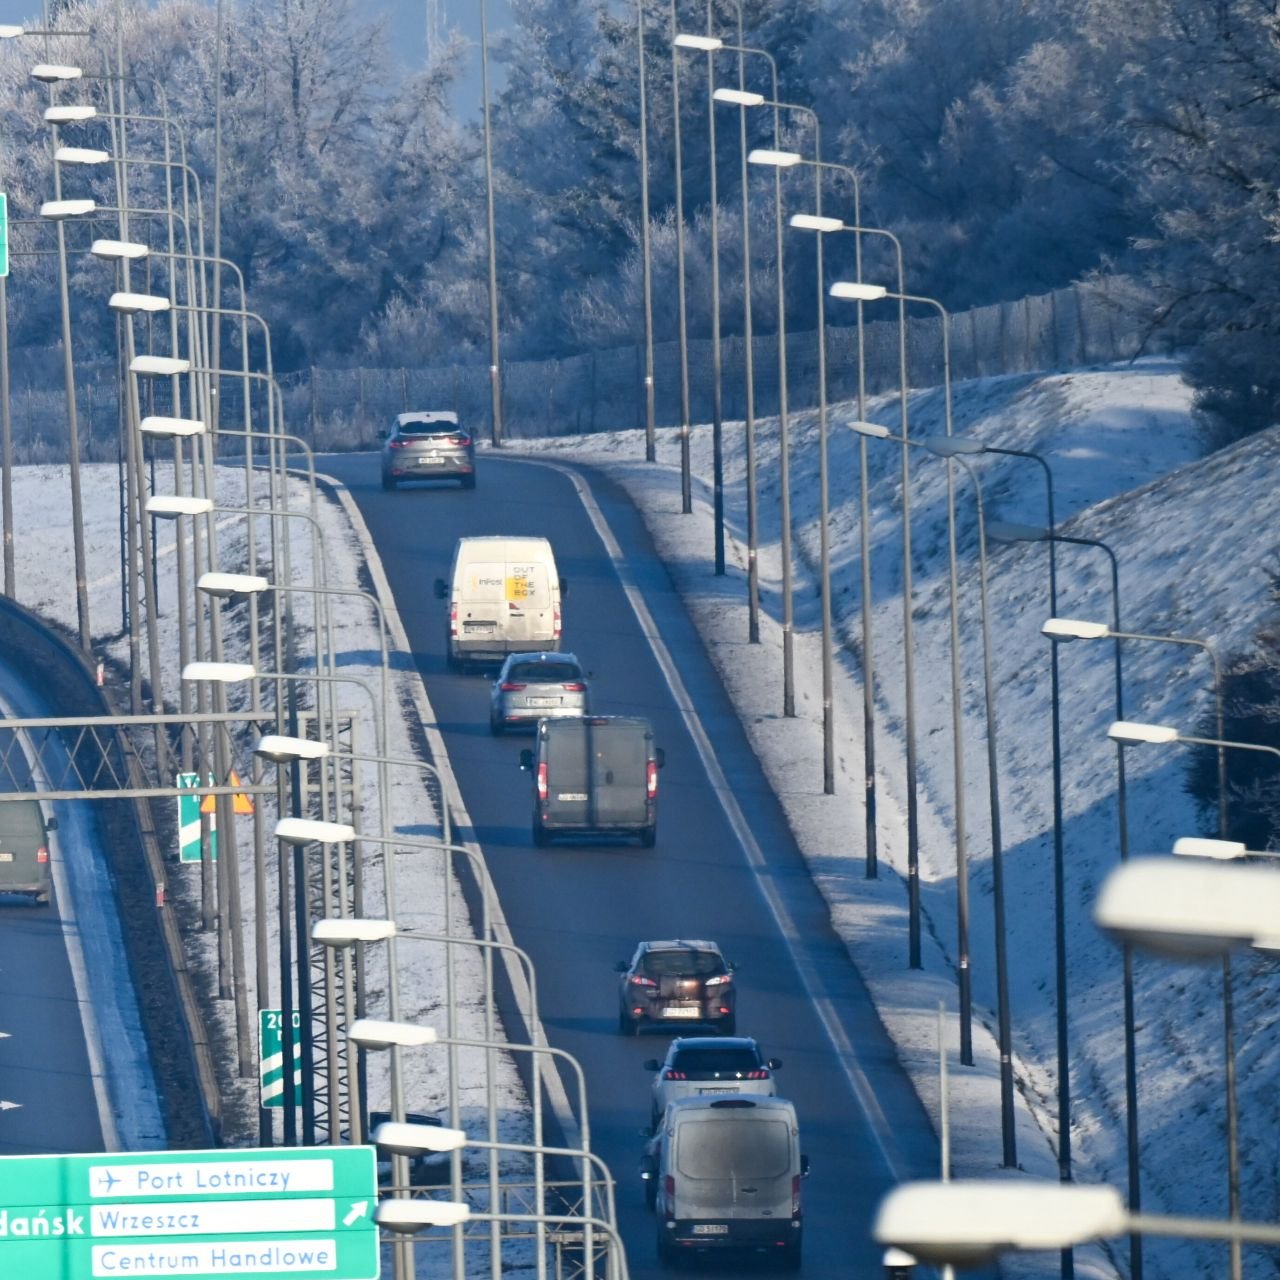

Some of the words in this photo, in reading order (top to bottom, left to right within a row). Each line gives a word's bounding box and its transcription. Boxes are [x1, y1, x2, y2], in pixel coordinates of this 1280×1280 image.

[137, 1171, 183, 1189] Port
[195, 1170, 290, 1192] Lotniczy
[98, 1212, 199, 1230] Wrzeszcz
[100, 1251, 198, 1271] Centrum
[210, 1247, 328, 1268] Handlowe
